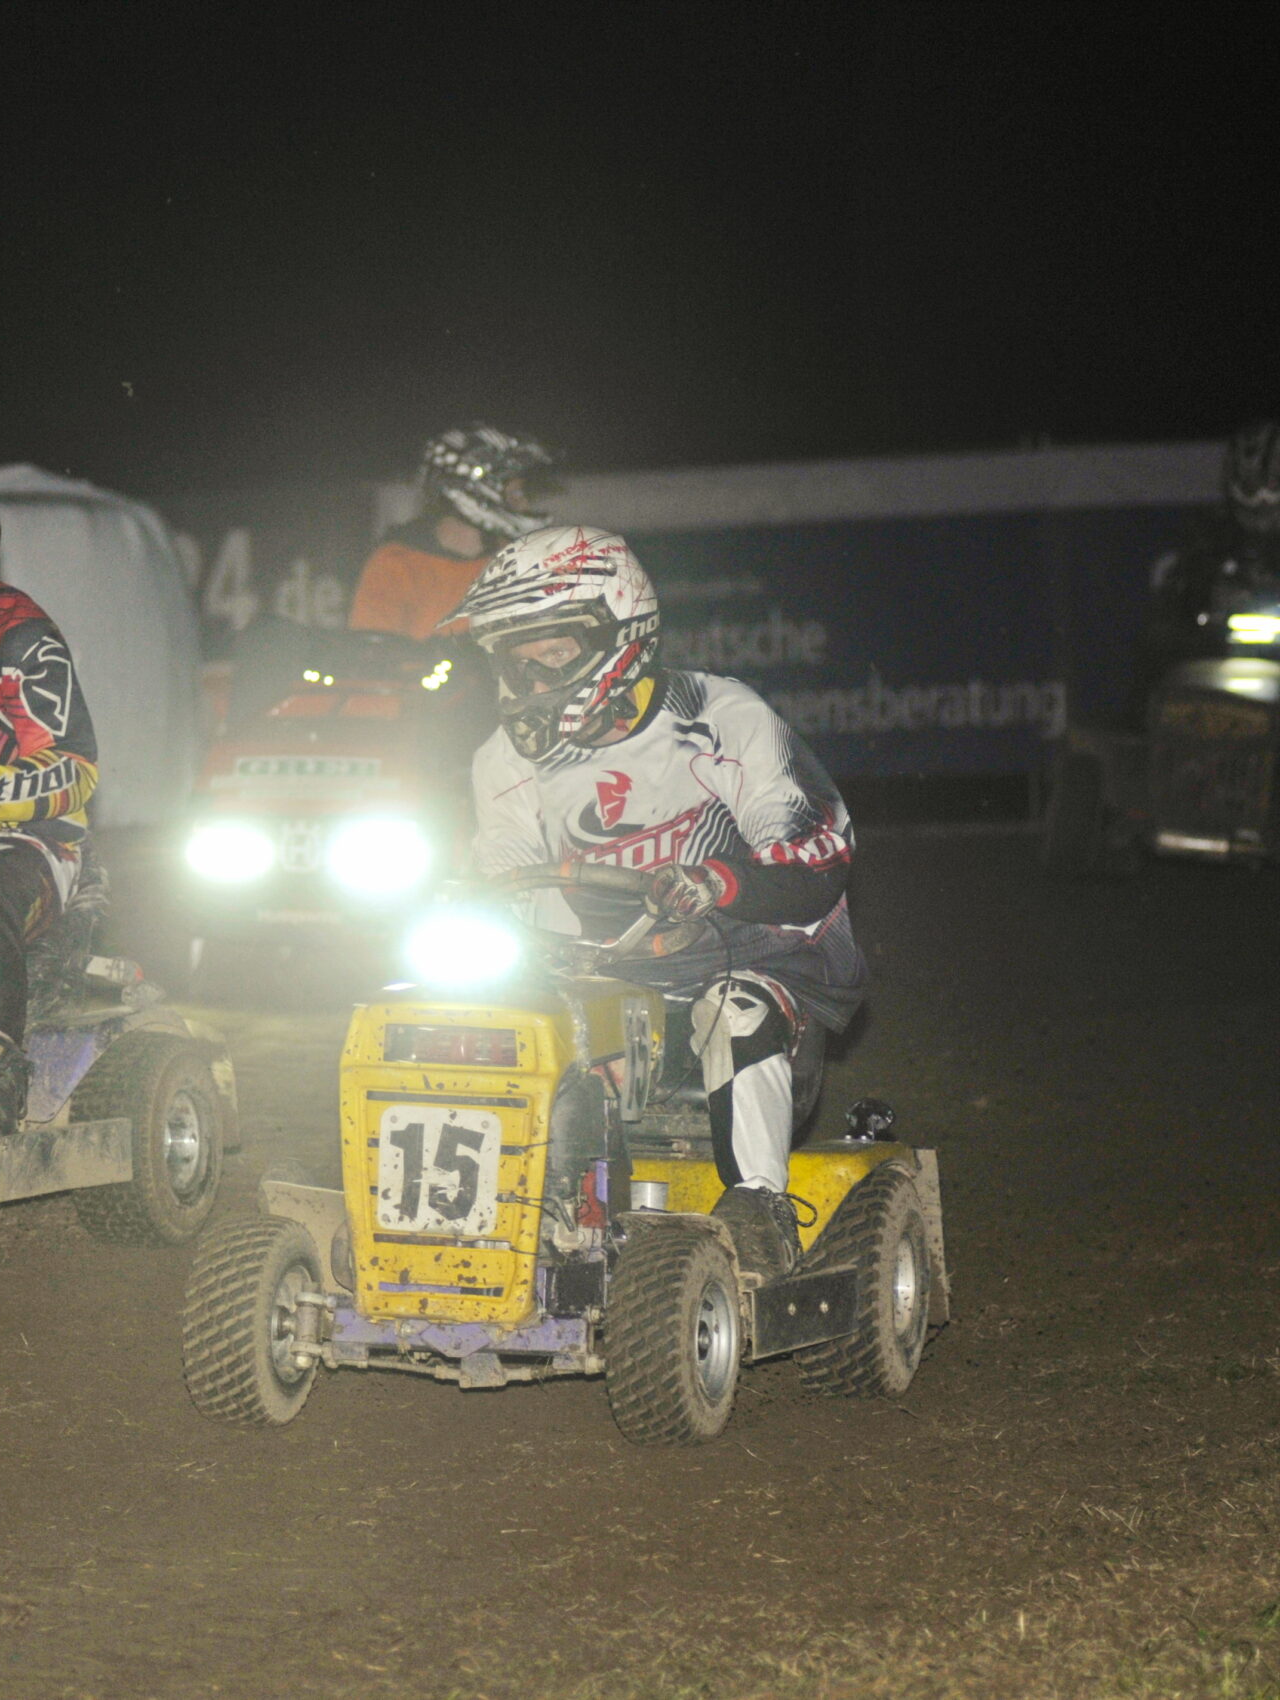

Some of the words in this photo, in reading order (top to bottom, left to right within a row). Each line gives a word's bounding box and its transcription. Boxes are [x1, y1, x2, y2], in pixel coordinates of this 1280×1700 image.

[615, 612, 661, 648] tho
[660, 608, 829, 667] eutsche
[773, 671, 1066, 738] ensberatung
[390, 1123, 486, 1220] 15
